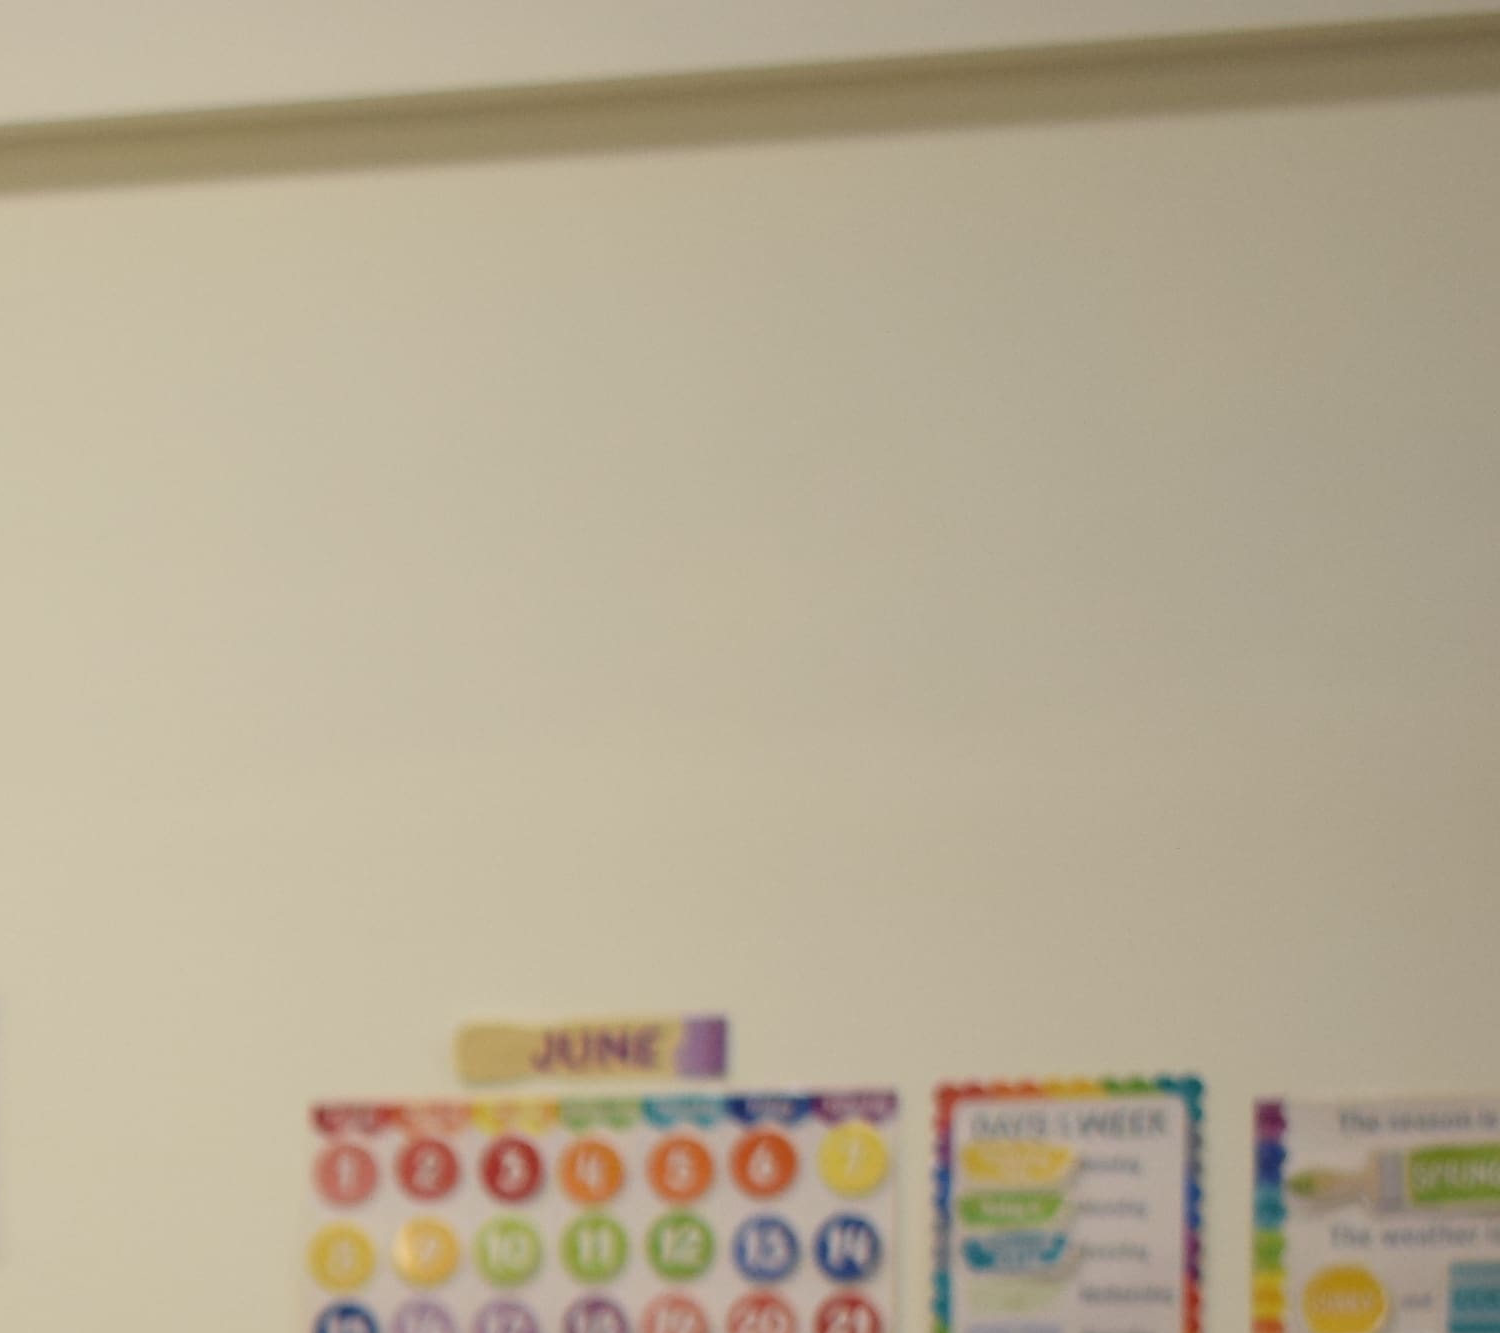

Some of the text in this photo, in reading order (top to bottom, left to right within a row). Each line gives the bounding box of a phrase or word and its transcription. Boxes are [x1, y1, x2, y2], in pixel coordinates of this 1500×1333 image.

[529, 1024, 662, 1073] JUNE
[1079, 1107, 1169, 1139] WEEK
[1338, 1109, 1381, 1133] The
[1330, 1224, 1373, 1247] The
